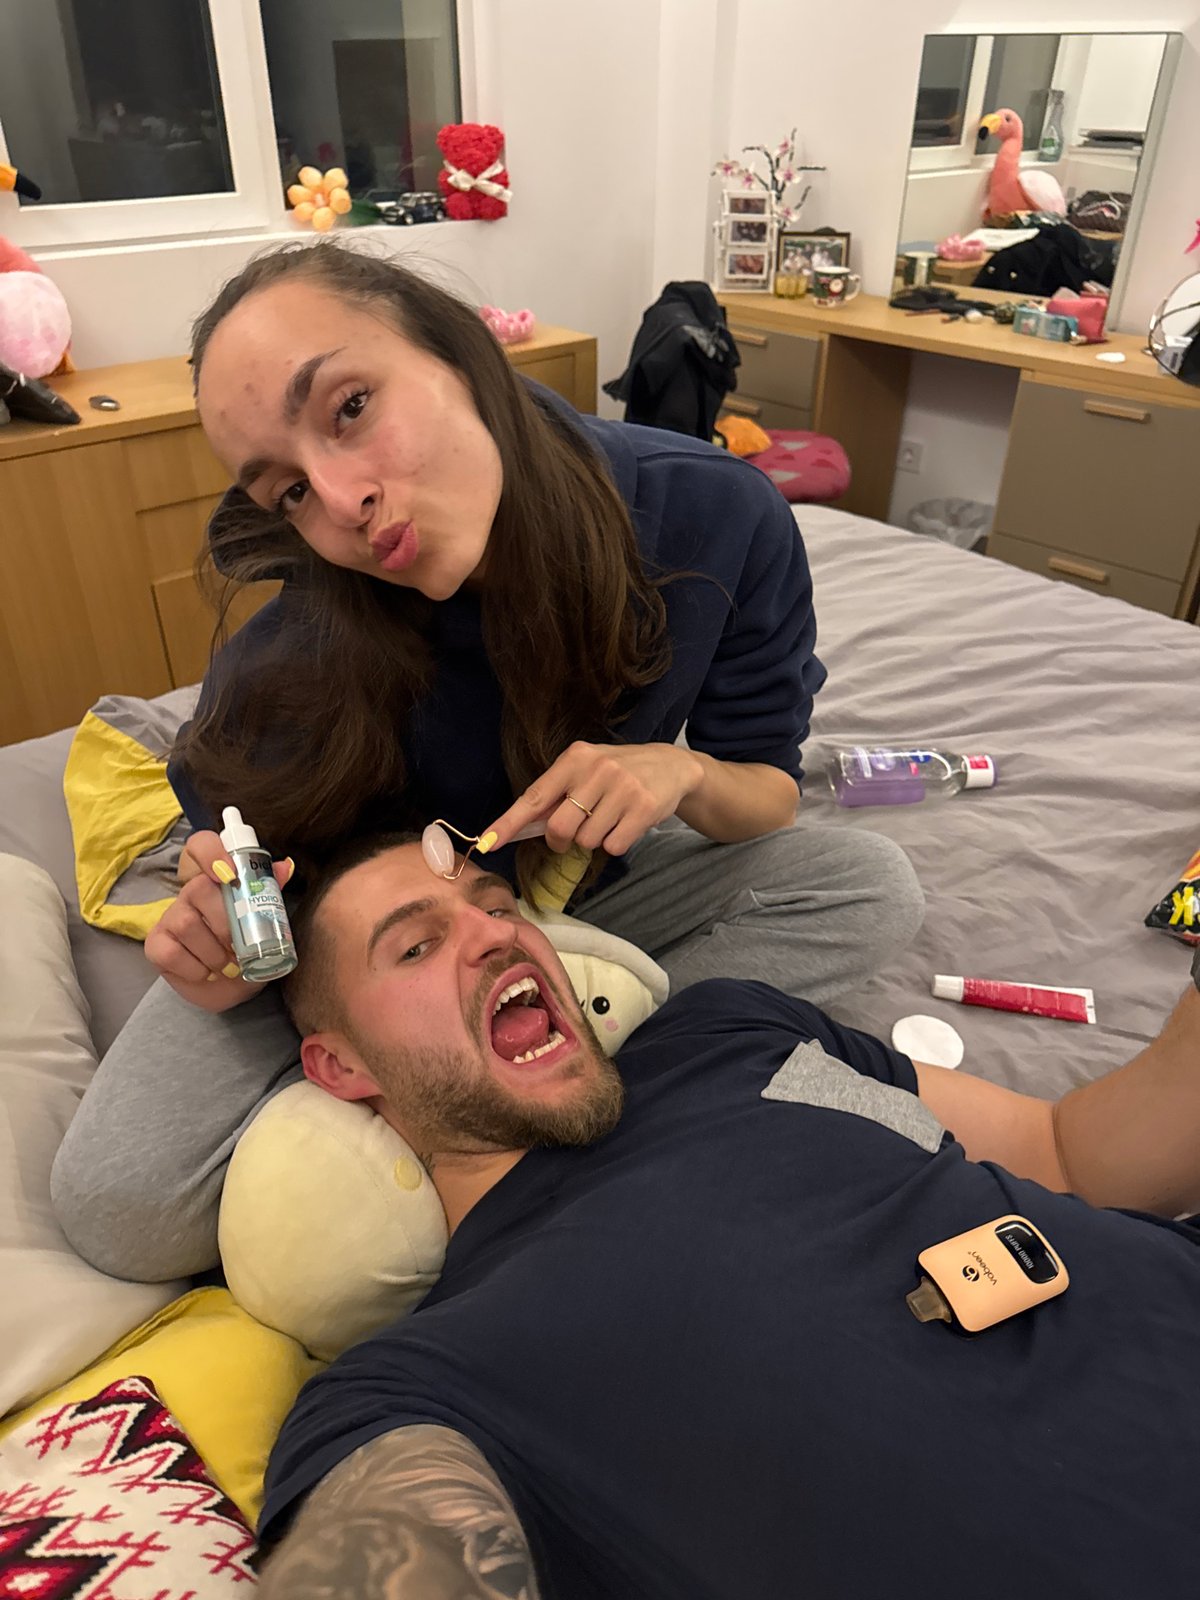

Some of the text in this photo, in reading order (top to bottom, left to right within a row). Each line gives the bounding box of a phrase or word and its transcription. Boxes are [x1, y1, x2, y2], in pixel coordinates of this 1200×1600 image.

[248, 895, 279, 904] HYDRO
[971, 1251, 998, 1286] vabeen
[1005, 1233, 1035, 1270] 10000 PUFFS
